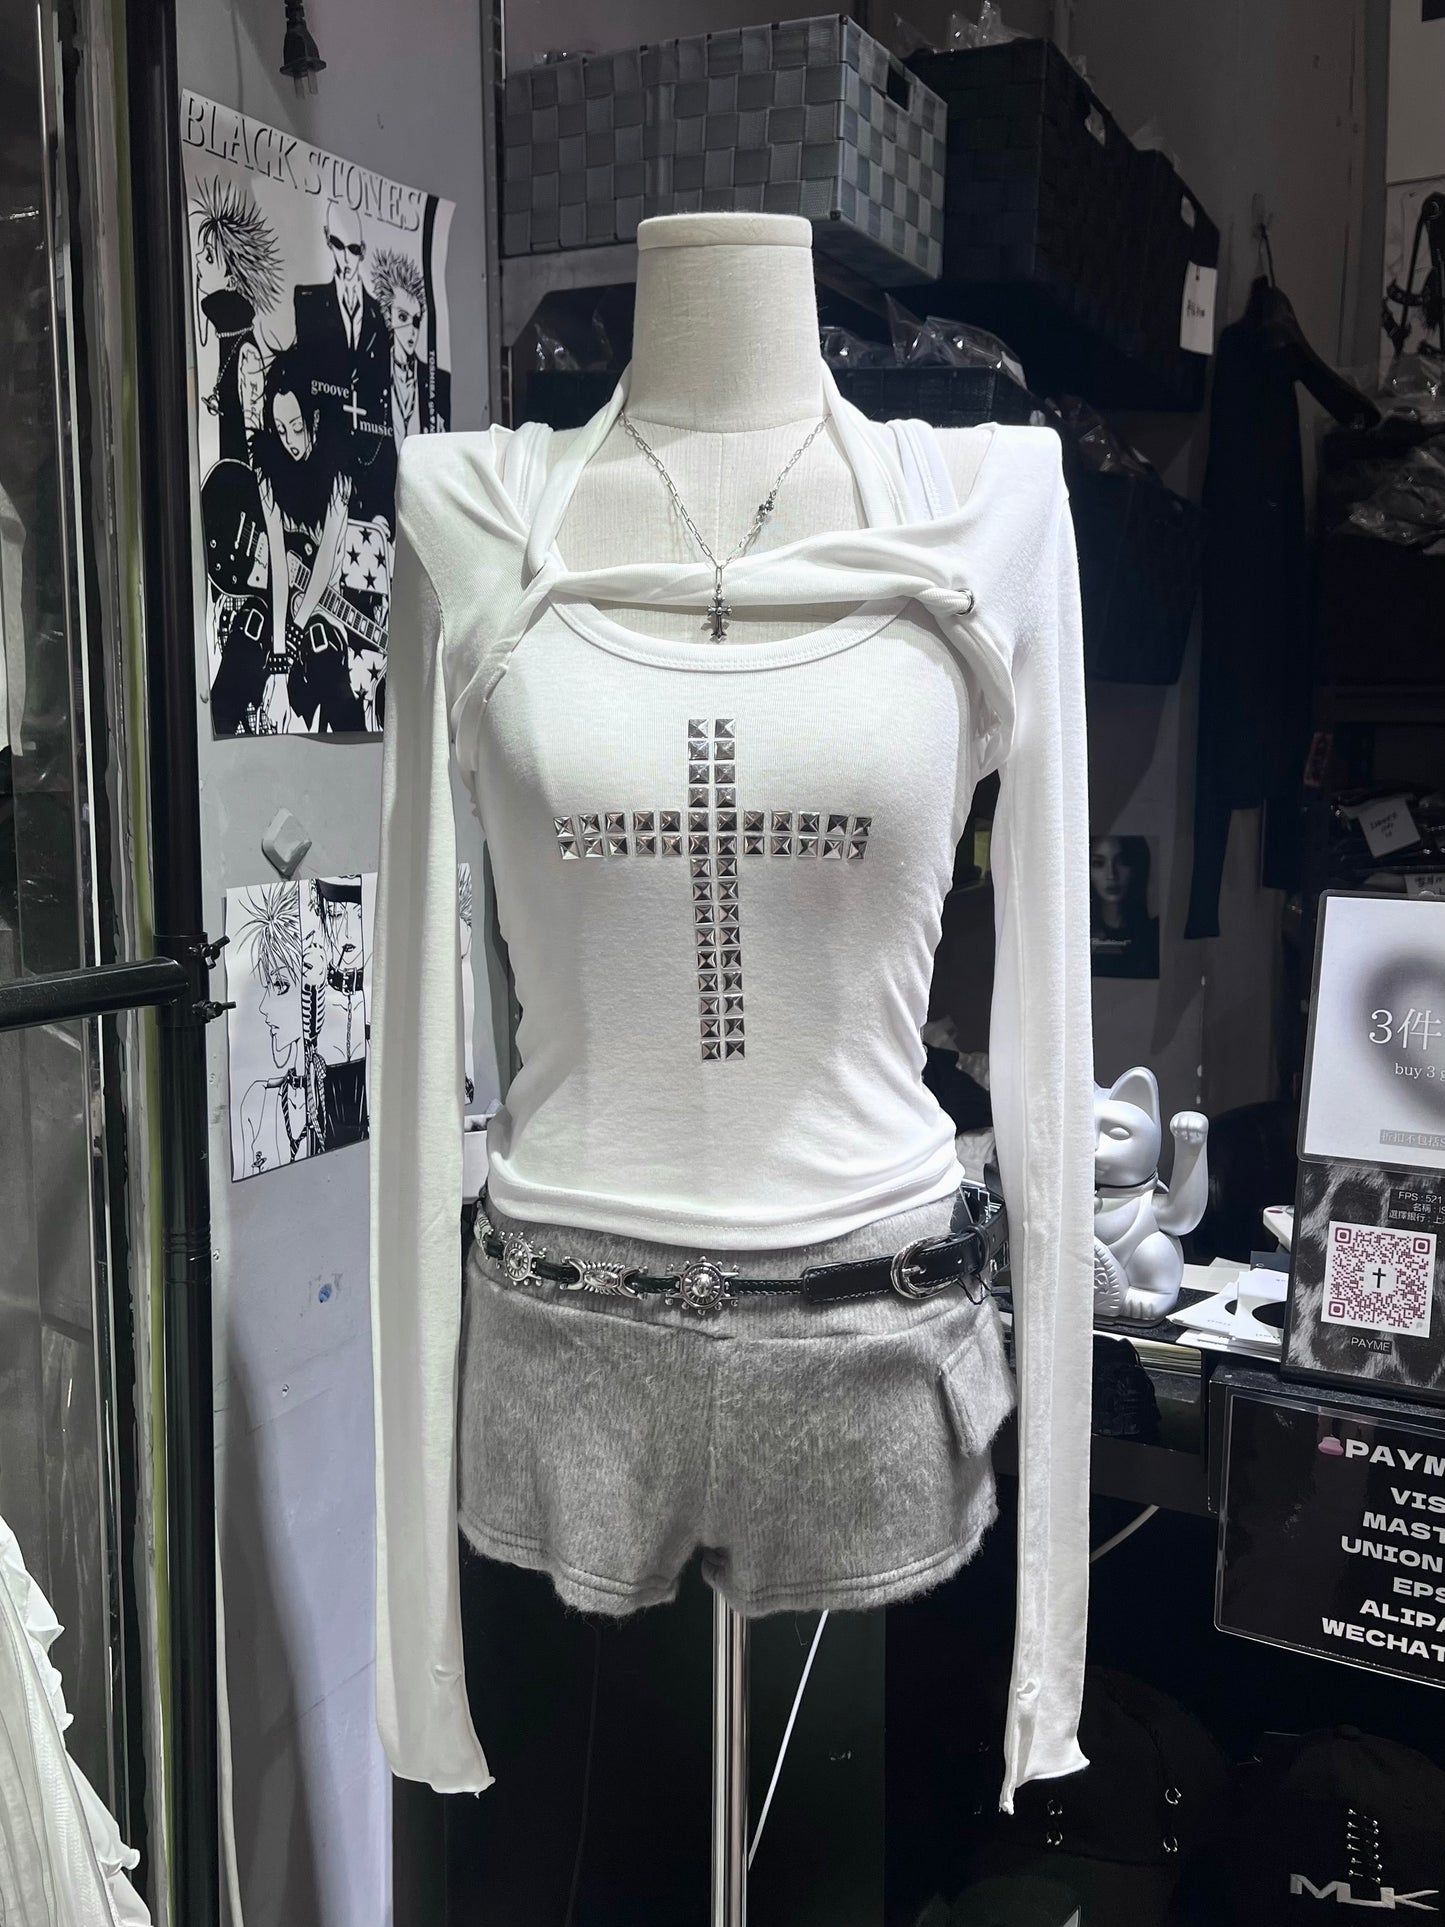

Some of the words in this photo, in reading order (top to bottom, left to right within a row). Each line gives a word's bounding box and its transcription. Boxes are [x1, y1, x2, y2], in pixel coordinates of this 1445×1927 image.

[183, 97, 298, 189] BLACK
[304, 151, 422, 232] STONES
[311, 379, 350, 399] groove
[428, 350, 436, 399] TOSHIBA
[360, 420, 394, 437] music
[1395, 1062, 1422, 1080] buy
[1426, 1065, 1436, 1078] 3
[1351, 1336, 1391, 1351] PAYME
[1390, 1486, 1445, 1514] VIS
[1362, 1511, 1445, 1544] MAST
[1341, 1535, 1443, 1573] UNION
[1321, 1617, 1445, 1663] WECHAT
